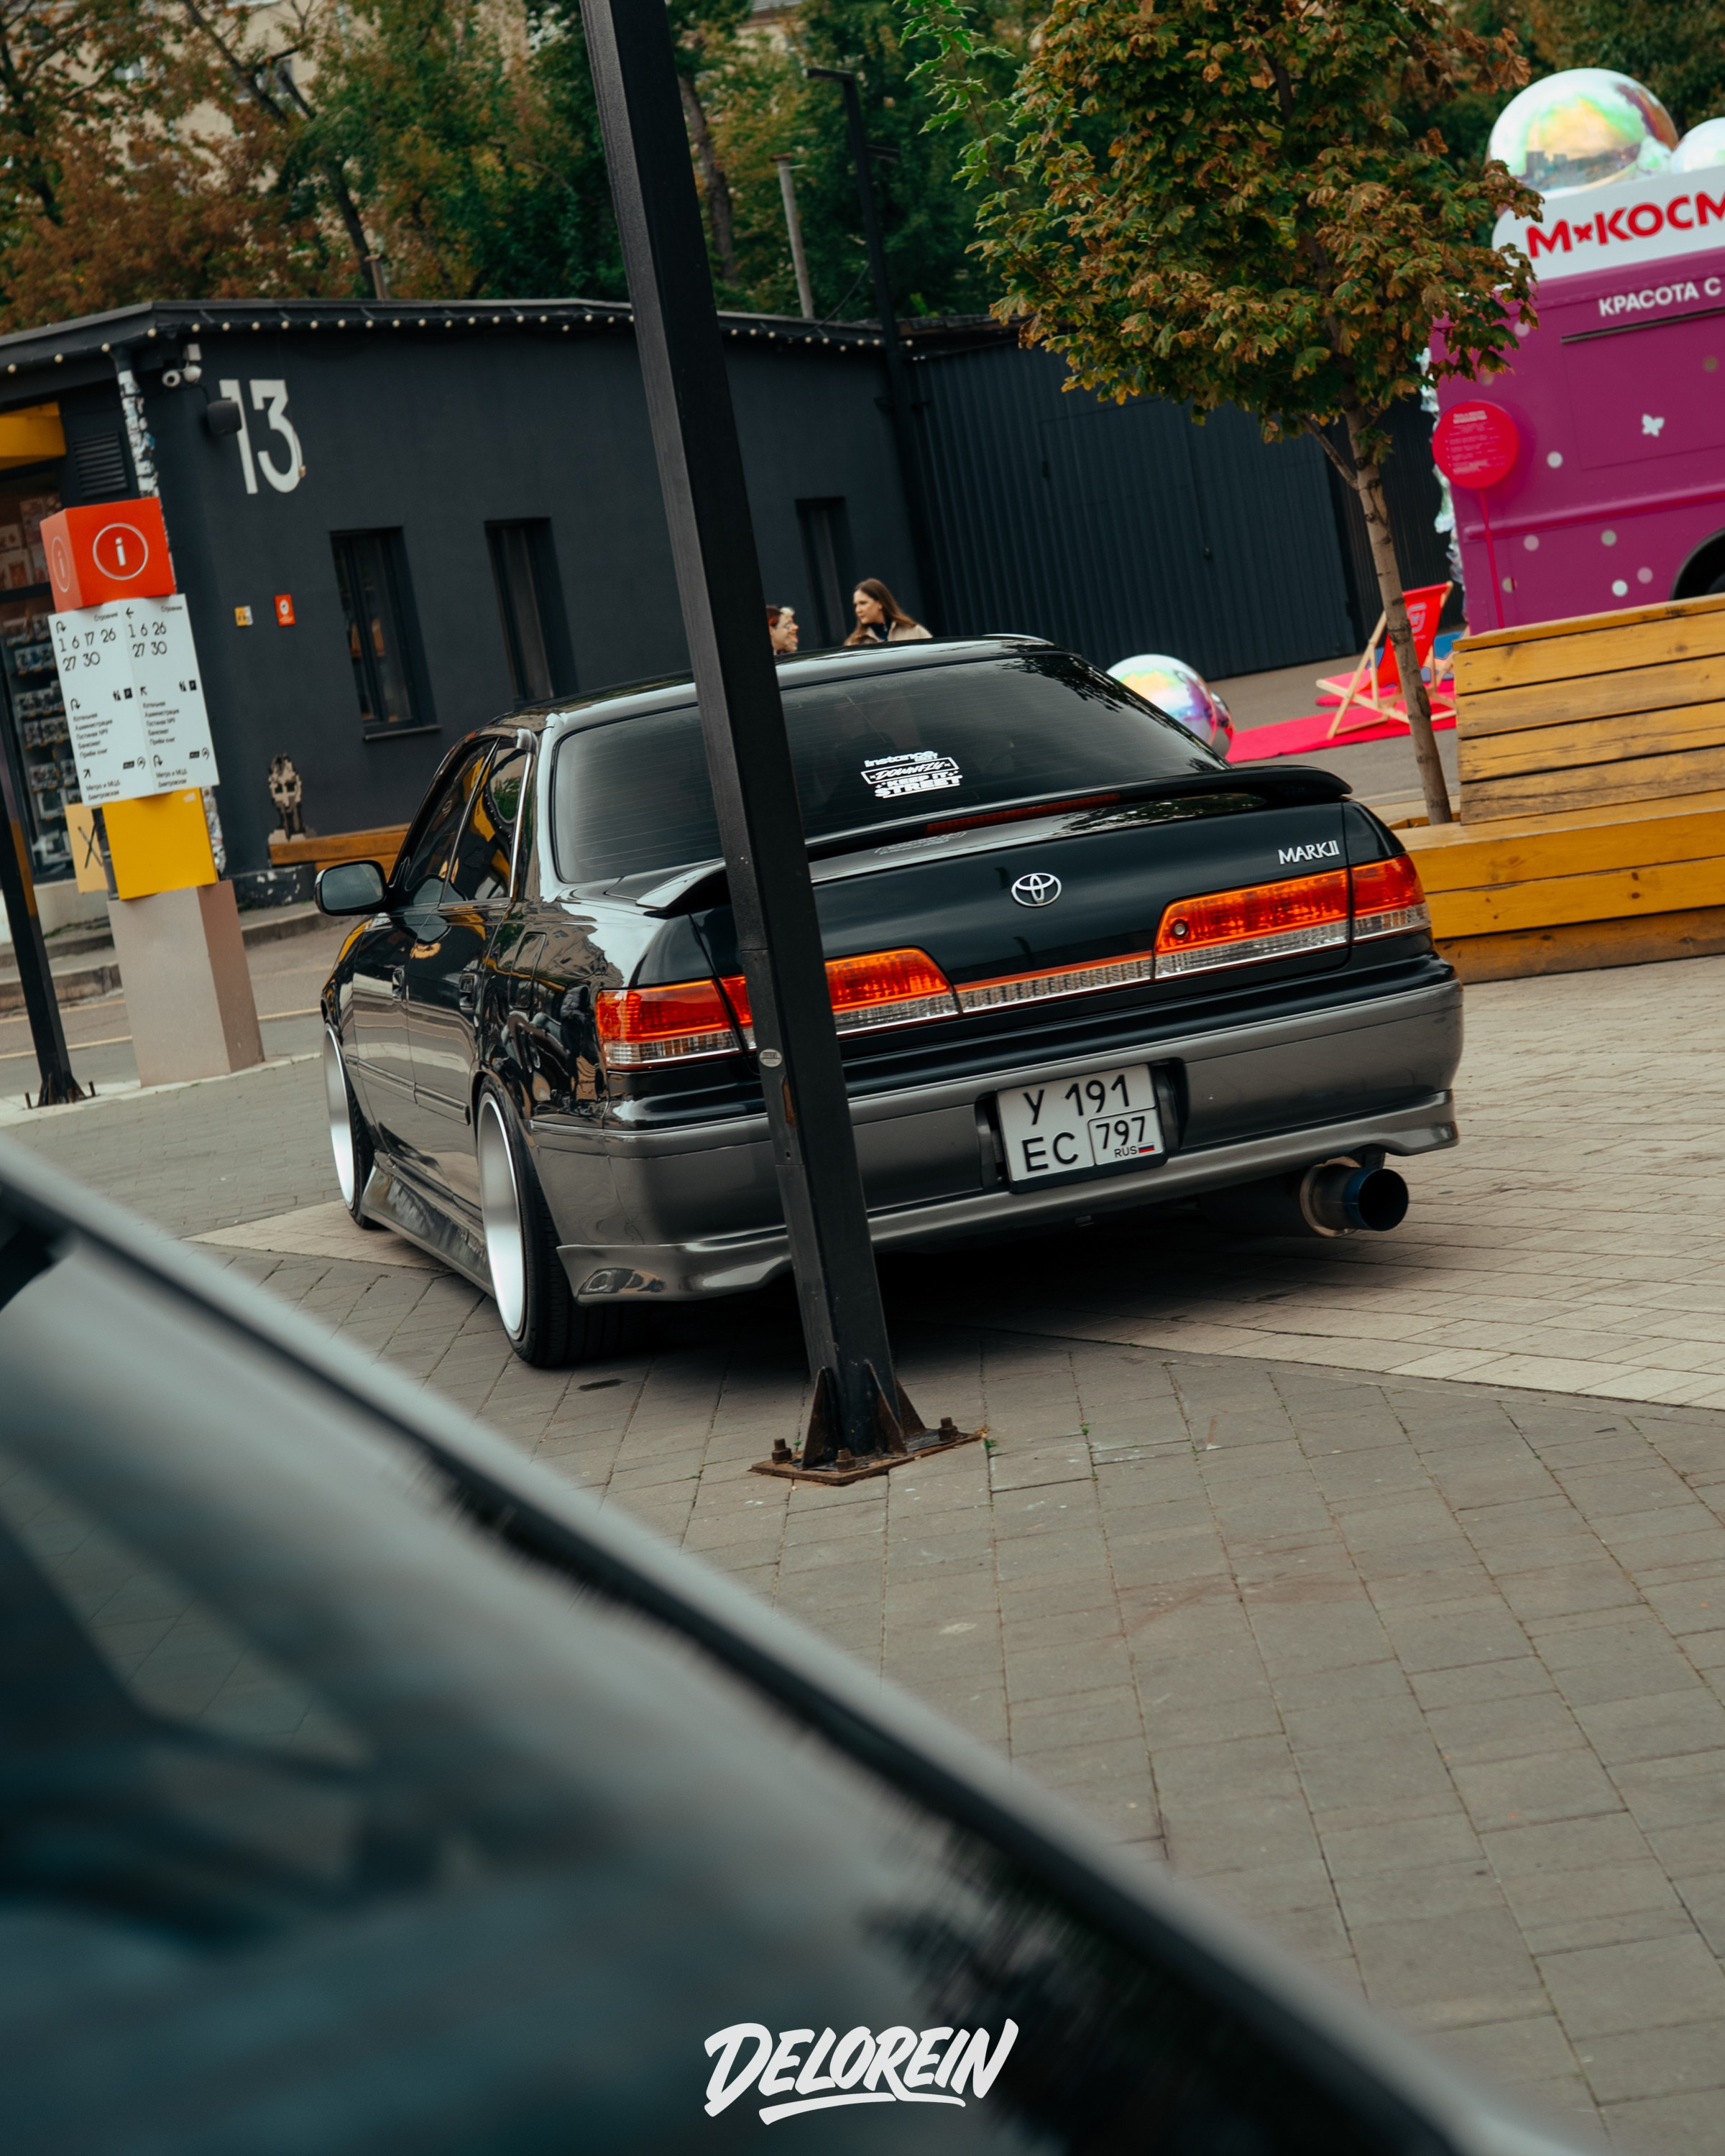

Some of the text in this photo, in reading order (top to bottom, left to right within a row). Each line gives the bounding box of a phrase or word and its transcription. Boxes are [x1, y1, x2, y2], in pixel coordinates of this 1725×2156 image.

[1598, 281, 1700, 316] КРАСОТА
[219, 378, 303, 494] 13
[58, 627, 116, 653] 1 6 17 26
[128, 621, 167, 638] 1 6 26
[132, 641, 167, 658] 27 30
[63, 651, 100, 671] 27 30
[875, 775, 963, 797] STREET
[887, 775, 929, 787] KEEP
[1064, 1074, 1129, 1116] 191
[1095, 1115, 1145, 1149] 797
[1114, 1146, 1137, 1158] RUS
